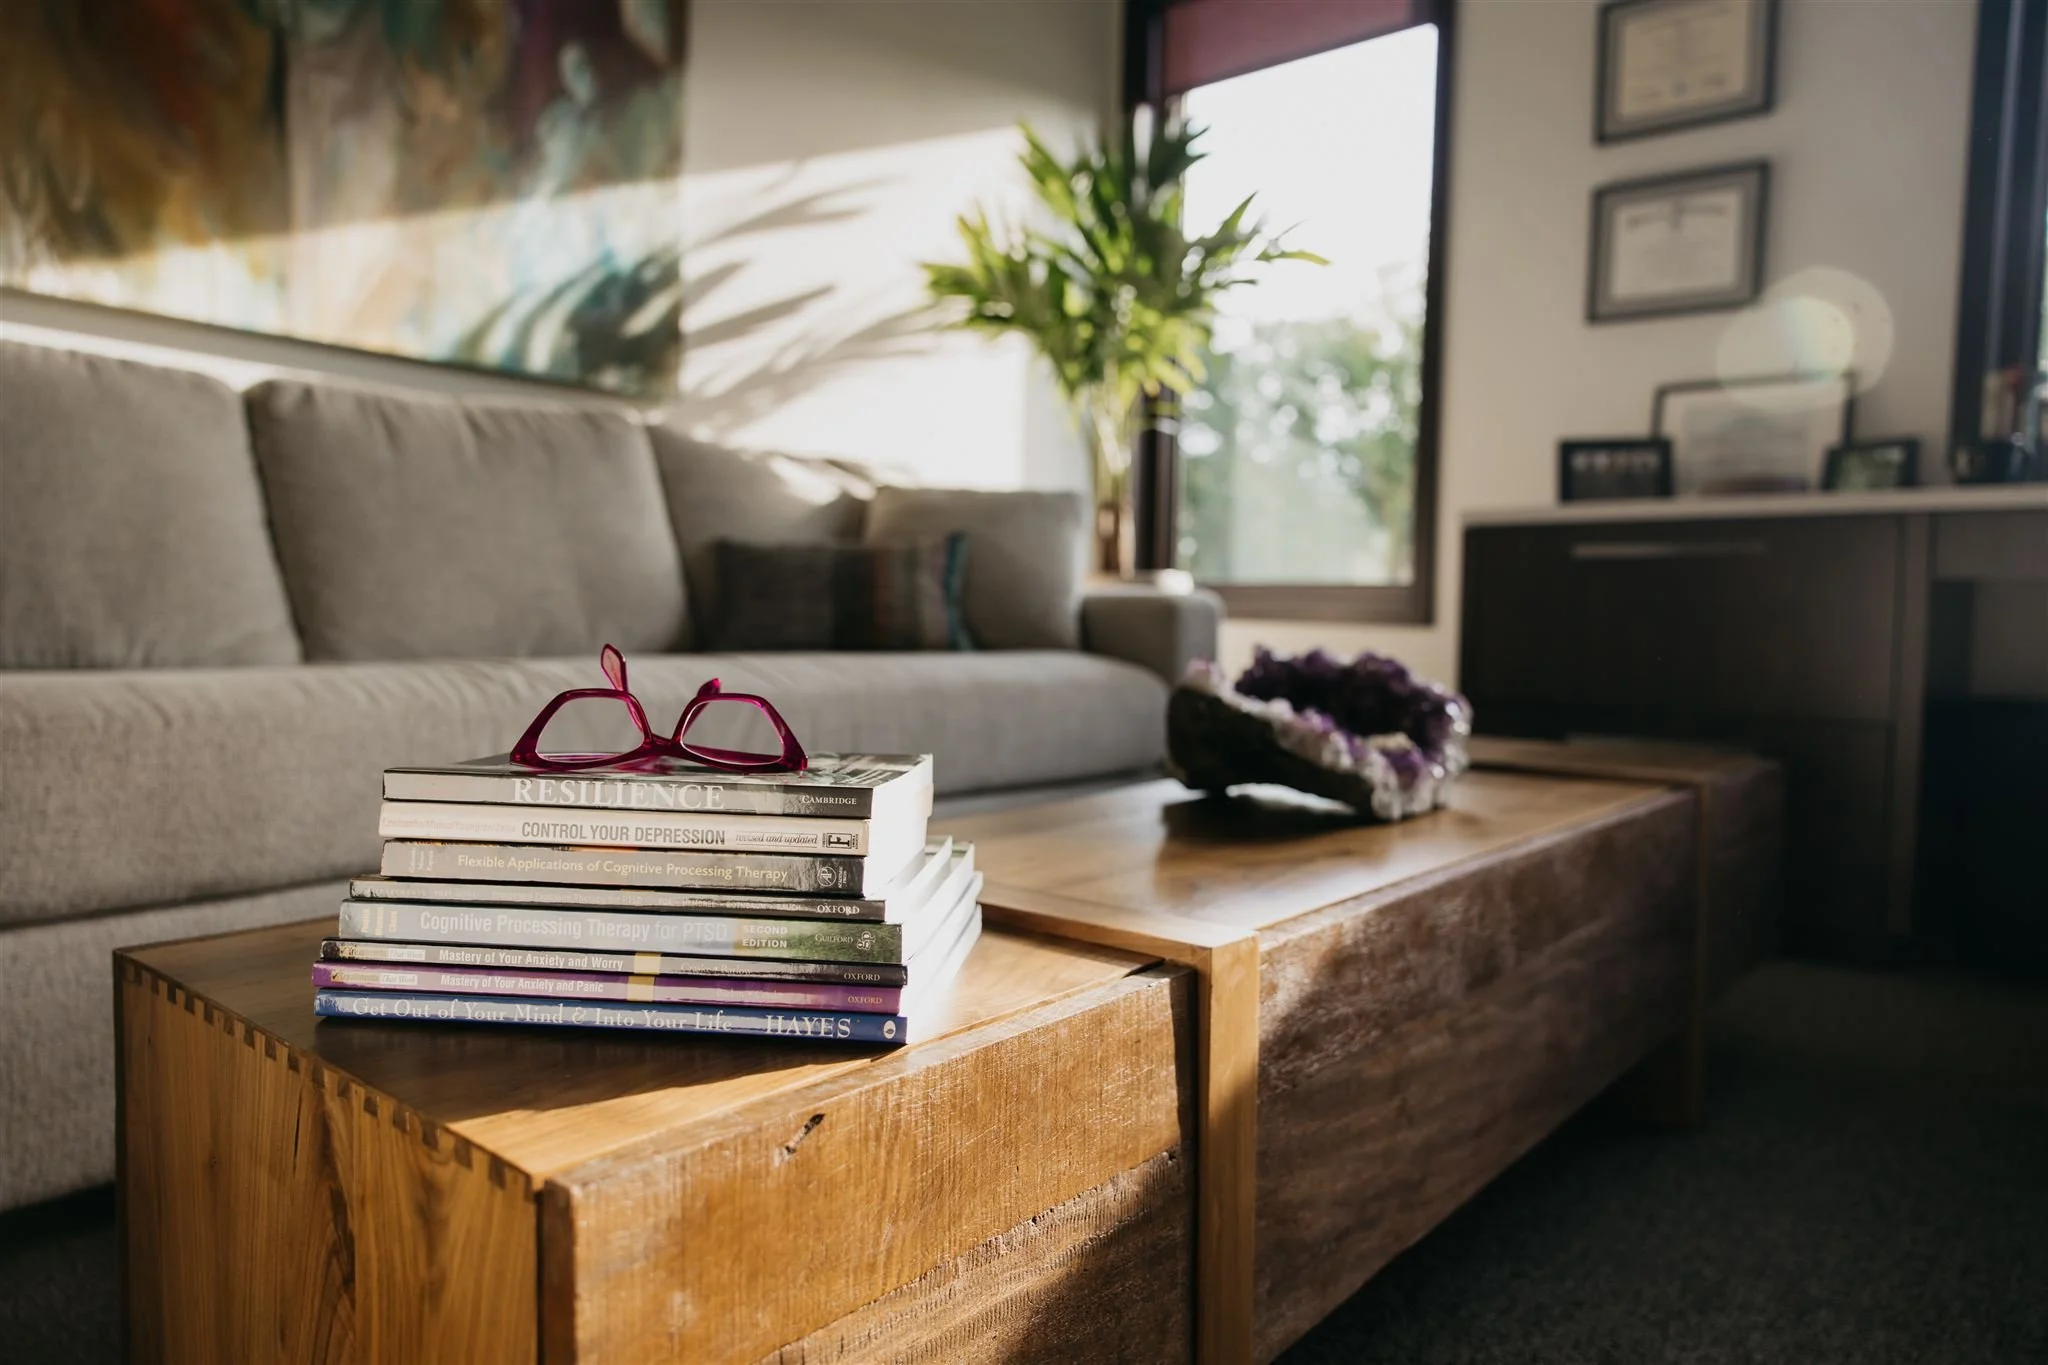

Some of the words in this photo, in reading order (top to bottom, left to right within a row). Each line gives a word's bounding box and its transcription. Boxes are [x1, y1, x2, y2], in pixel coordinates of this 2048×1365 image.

[511, 778, 725, 810] RESILIENCE
[801, 795, 857, 805] CAMBRIDGE
[521, 822, 588, 840] CONTROL
[590, 825, 630, 842] YOUR
[634, 827, 726, 846] DEPRESSION
[766, 834, 782, 843] and
[784, 834, 818, 846] updated
[457, 854, 505, 868] Flexible
[506, 857, 584, 872] Applications
[586, 860, 602, 872] of
[602, 860, 663, 876] Cognitive
[666, 863, 733, 880] Processing
[735, 865, 788, 882] Therapy
[816, 904, 860, 916] OXFORD
[419, 911, 492, 935] Cognitive
[496, 915, 583, 940] Processing
[586, 918, 650, 943] Therapy
[653, 920, 679, 938] for
[682, 923, 728, 942] PTSD
[742, 924, 788, 935] SECOND
[742, 939, 788, 949] EDITION
[439, 950, 482, 965] Mastery
[484, 951, 496, 964] of
[498, 952, 523, 965] Your
[525, 953, 565, 969] Anxiety
[567, 955, 588, 969] and
[591, 956, 624, 972] Worry
[440, 975, 479, 990] Mastery
[481, 976, 493, 988] of
[495, 977, 517, 989] Your
[517, 978, 554, 993] Anxiety
[556, 979, 574, 991] and
[576, 980, 604, 993] Panic
[843, 972, 881, 981] OXFORD
[847, 995, 883, 1005] OXFORD
[353, 997, 386, 1016] Get
[394, 998, 431, 1018] Out
[438, 998, 459, 1019] of
[462, 1001, 505, 1021] Your
[514, 1003, 564, 1024] Mind
[572, 1007, 587, 1025] &
[595, 1007, 635, 1026] Into
[641, 1009, 688, 1029] Your
[695, 1009, 733, 1032] Life
[765, 1014, 851, 1038] HAYES
